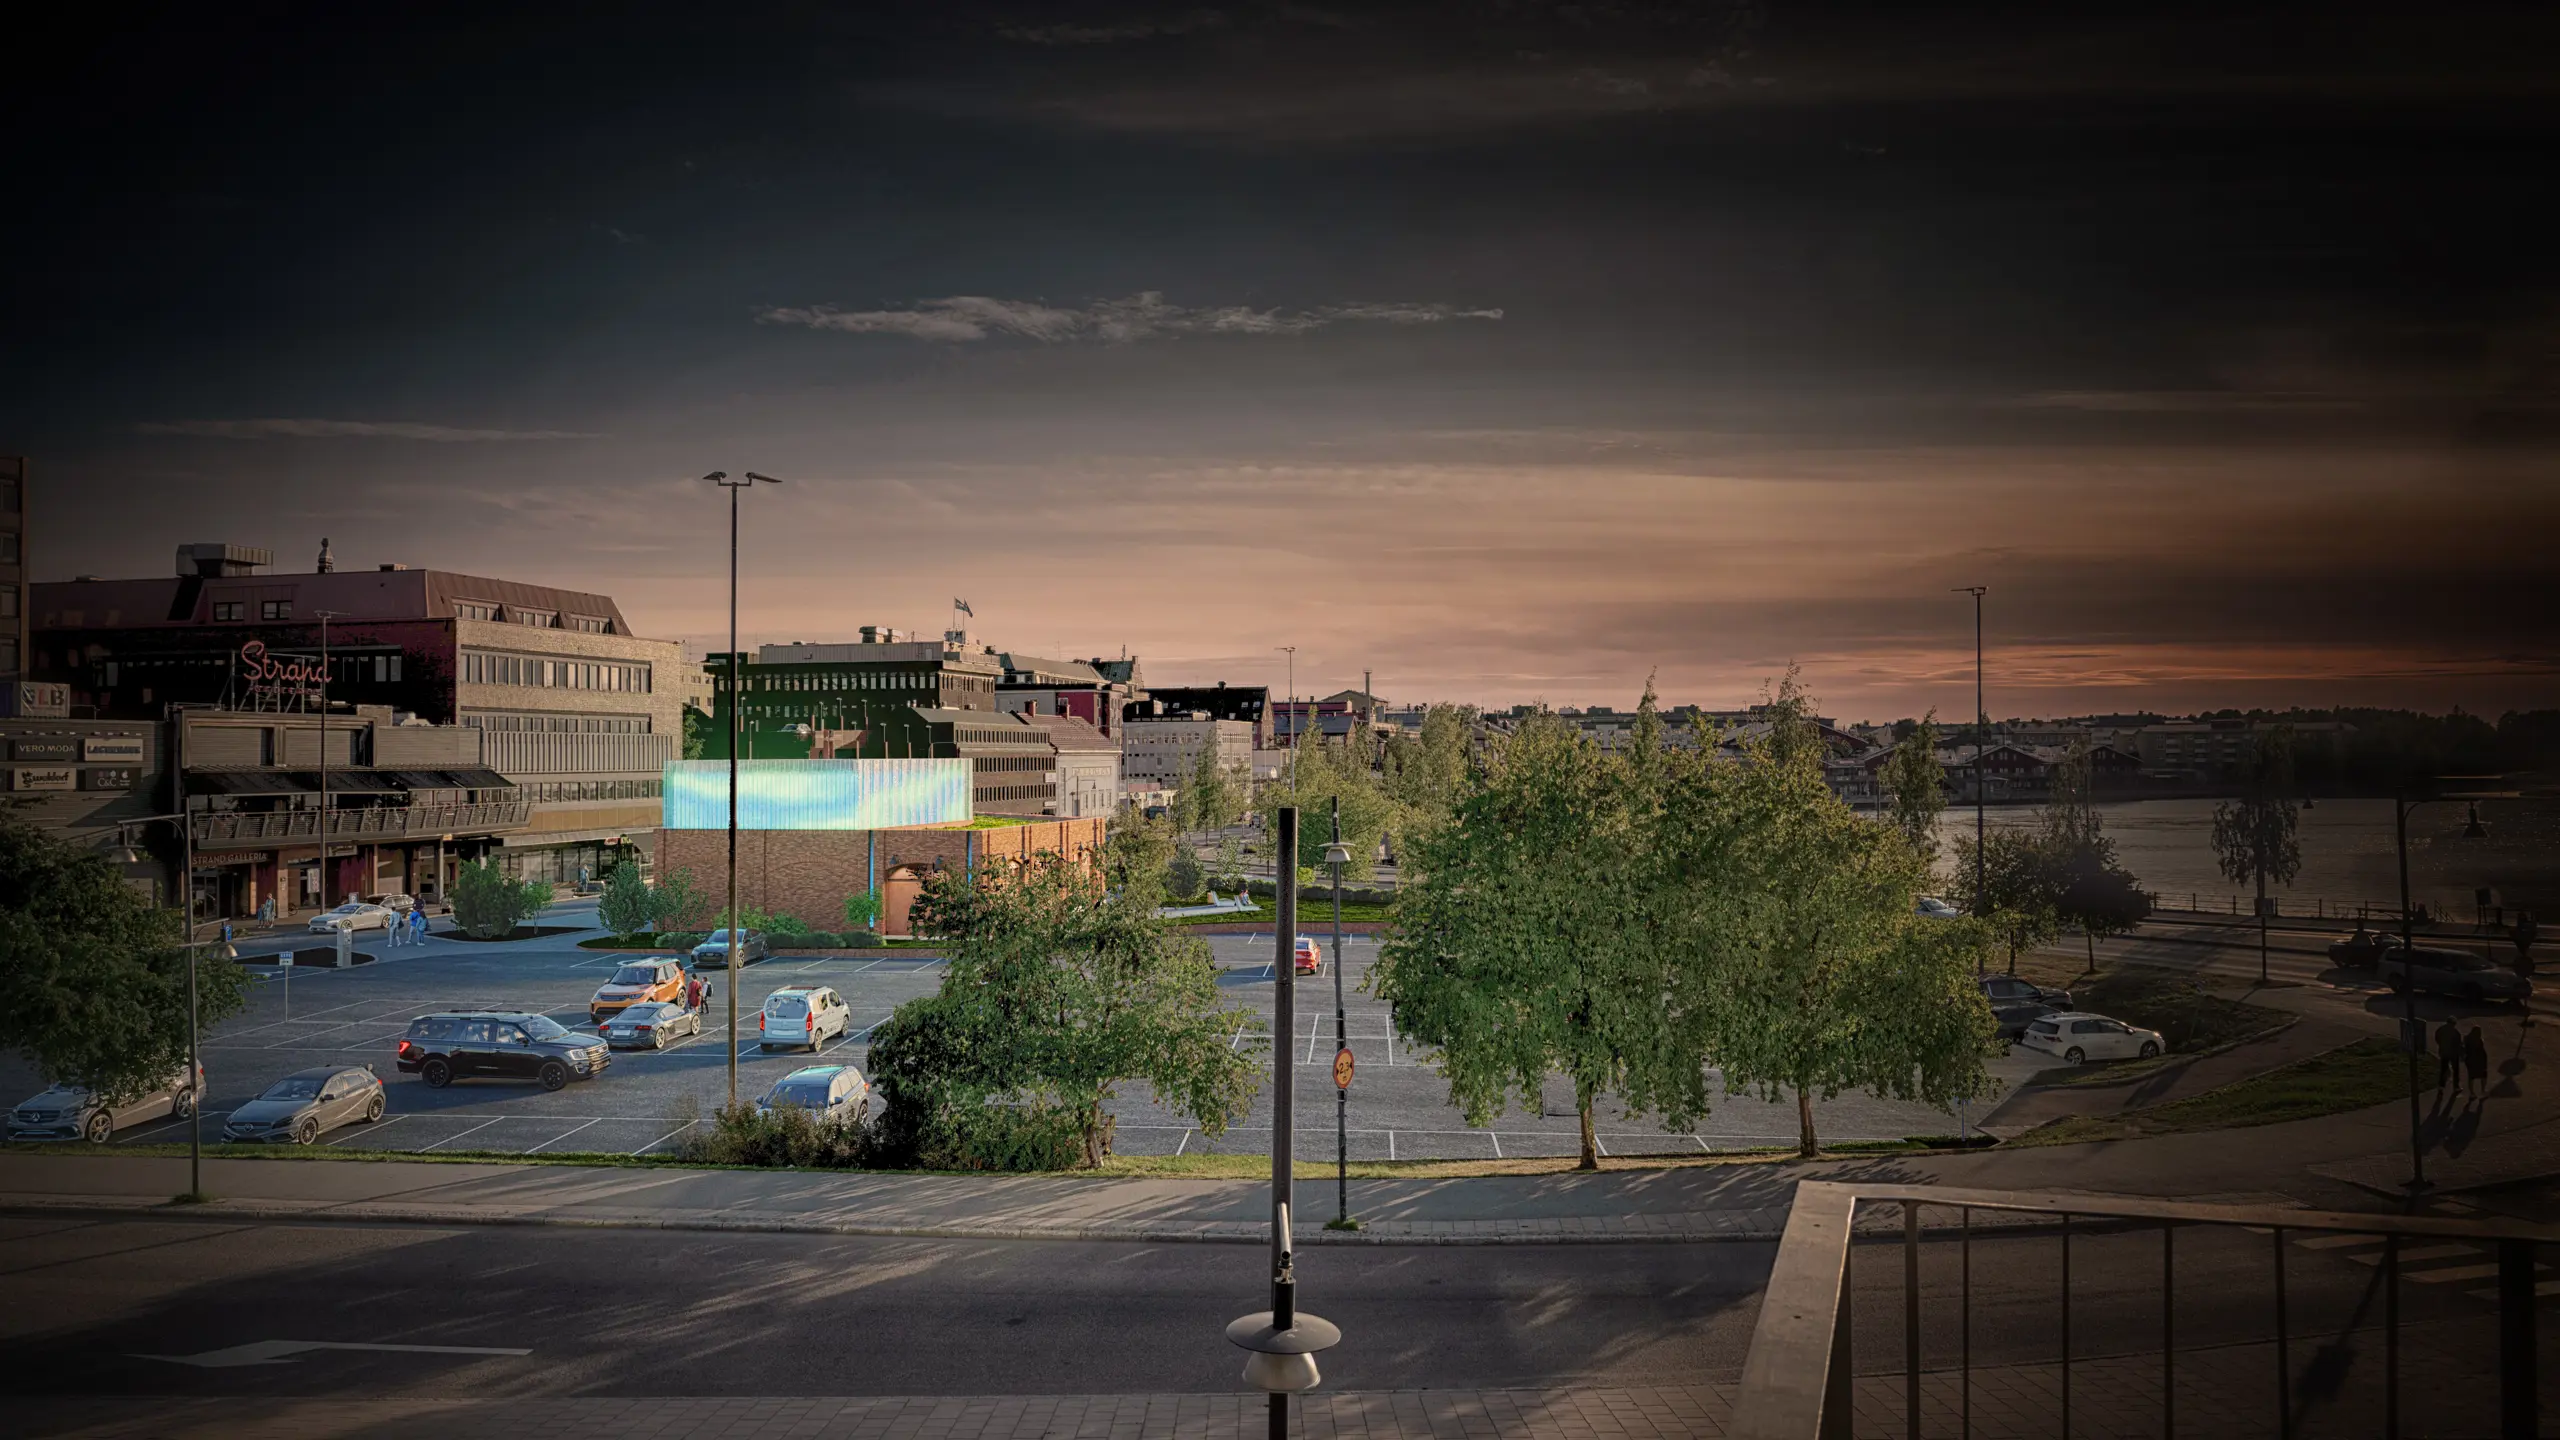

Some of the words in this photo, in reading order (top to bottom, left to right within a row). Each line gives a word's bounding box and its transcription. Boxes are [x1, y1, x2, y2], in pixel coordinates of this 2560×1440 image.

[241, 640, 332, 683] Strand
[97, 777, 117, 787] C&C
[192, 855, 226, 865] STRAND
